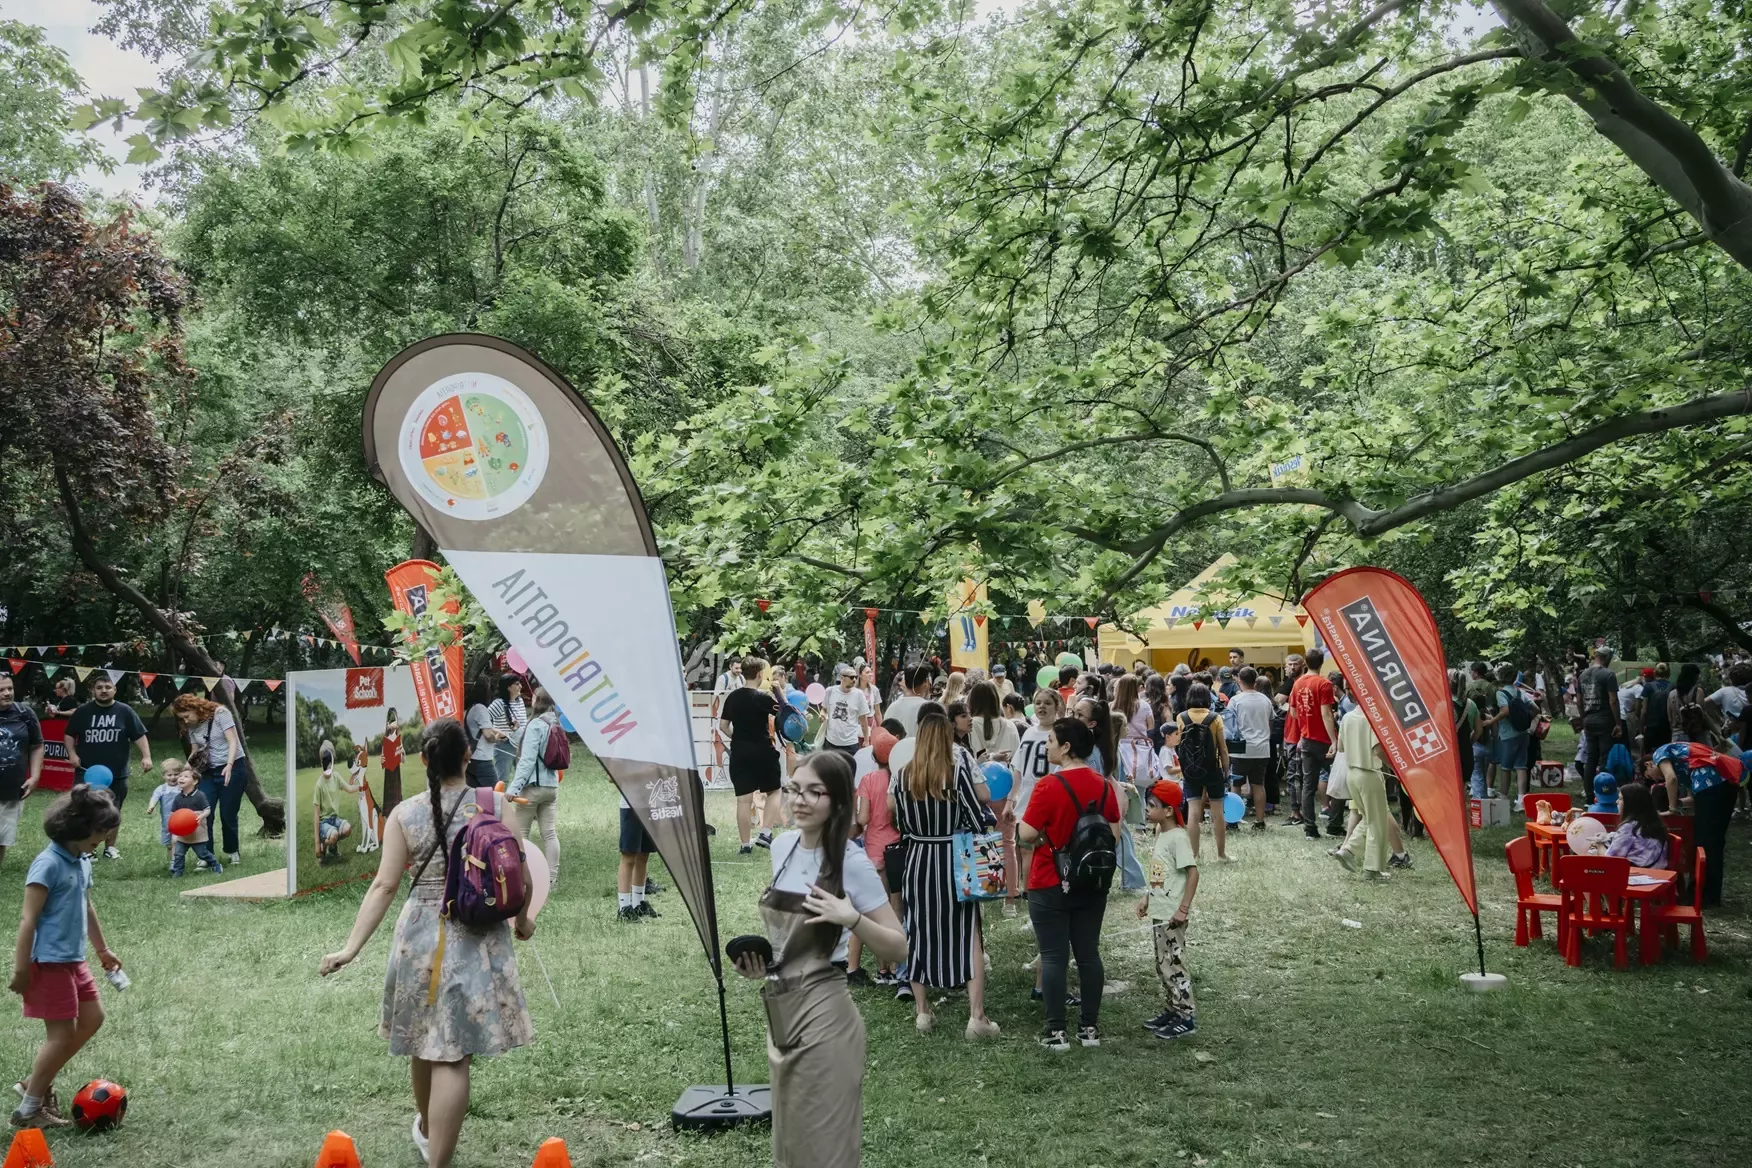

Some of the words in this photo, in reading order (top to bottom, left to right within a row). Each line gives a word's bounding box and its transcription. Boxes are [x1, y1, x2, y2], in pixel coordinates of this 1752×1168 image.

[91, 714, 96, 728] I
[97, 714, 116, 728] AM
[85, 728, 121, 743] GROOT
[43, 744, 69, 758] PURIN
